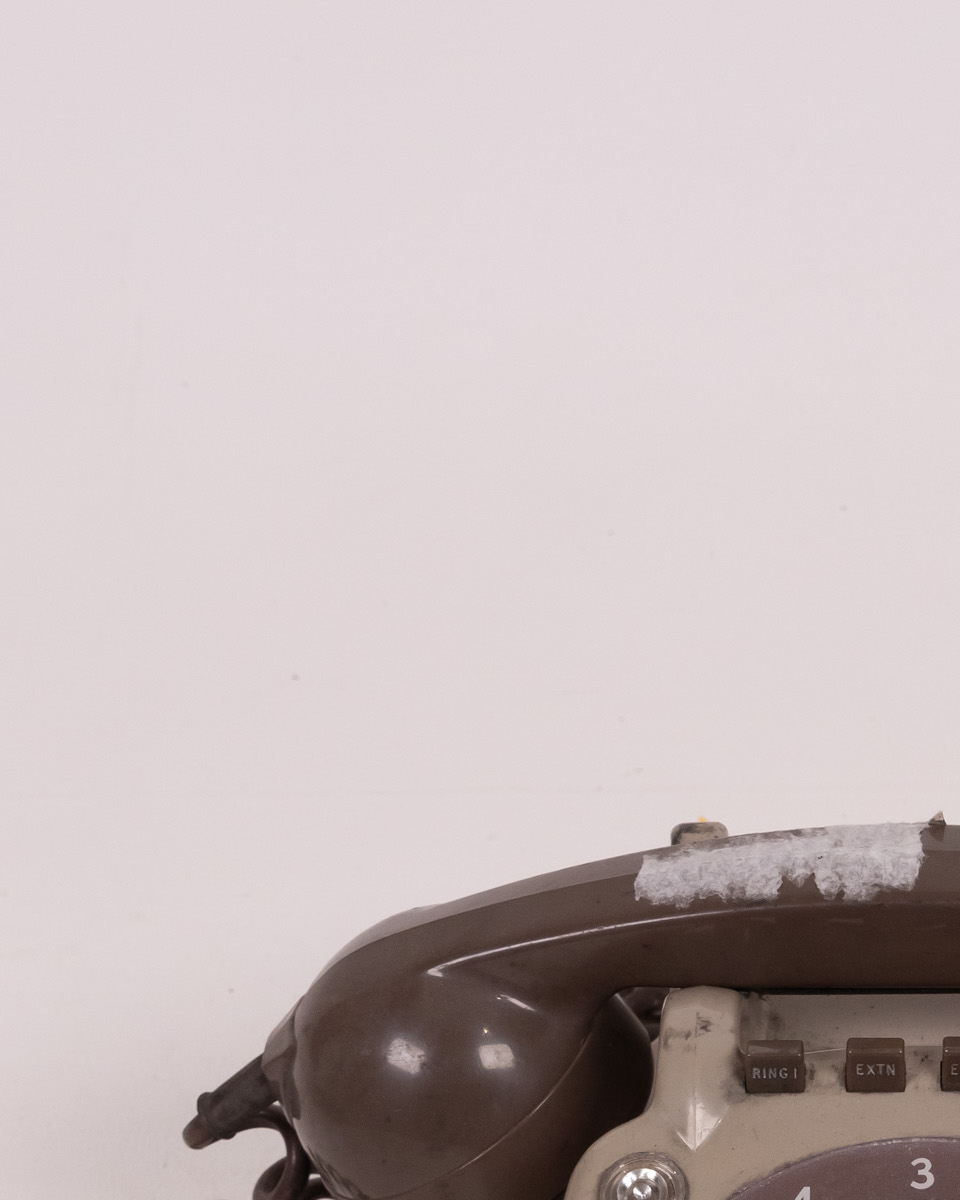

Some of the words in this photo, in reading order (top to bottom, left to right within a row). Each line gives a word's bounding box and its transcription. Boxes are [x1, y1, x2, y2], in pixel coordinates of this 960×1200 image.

[752, 1067, 788, 1079] RING
[856, 1063, 896, 1076] EXTN
[910, 1157, 935, 1190] 3
